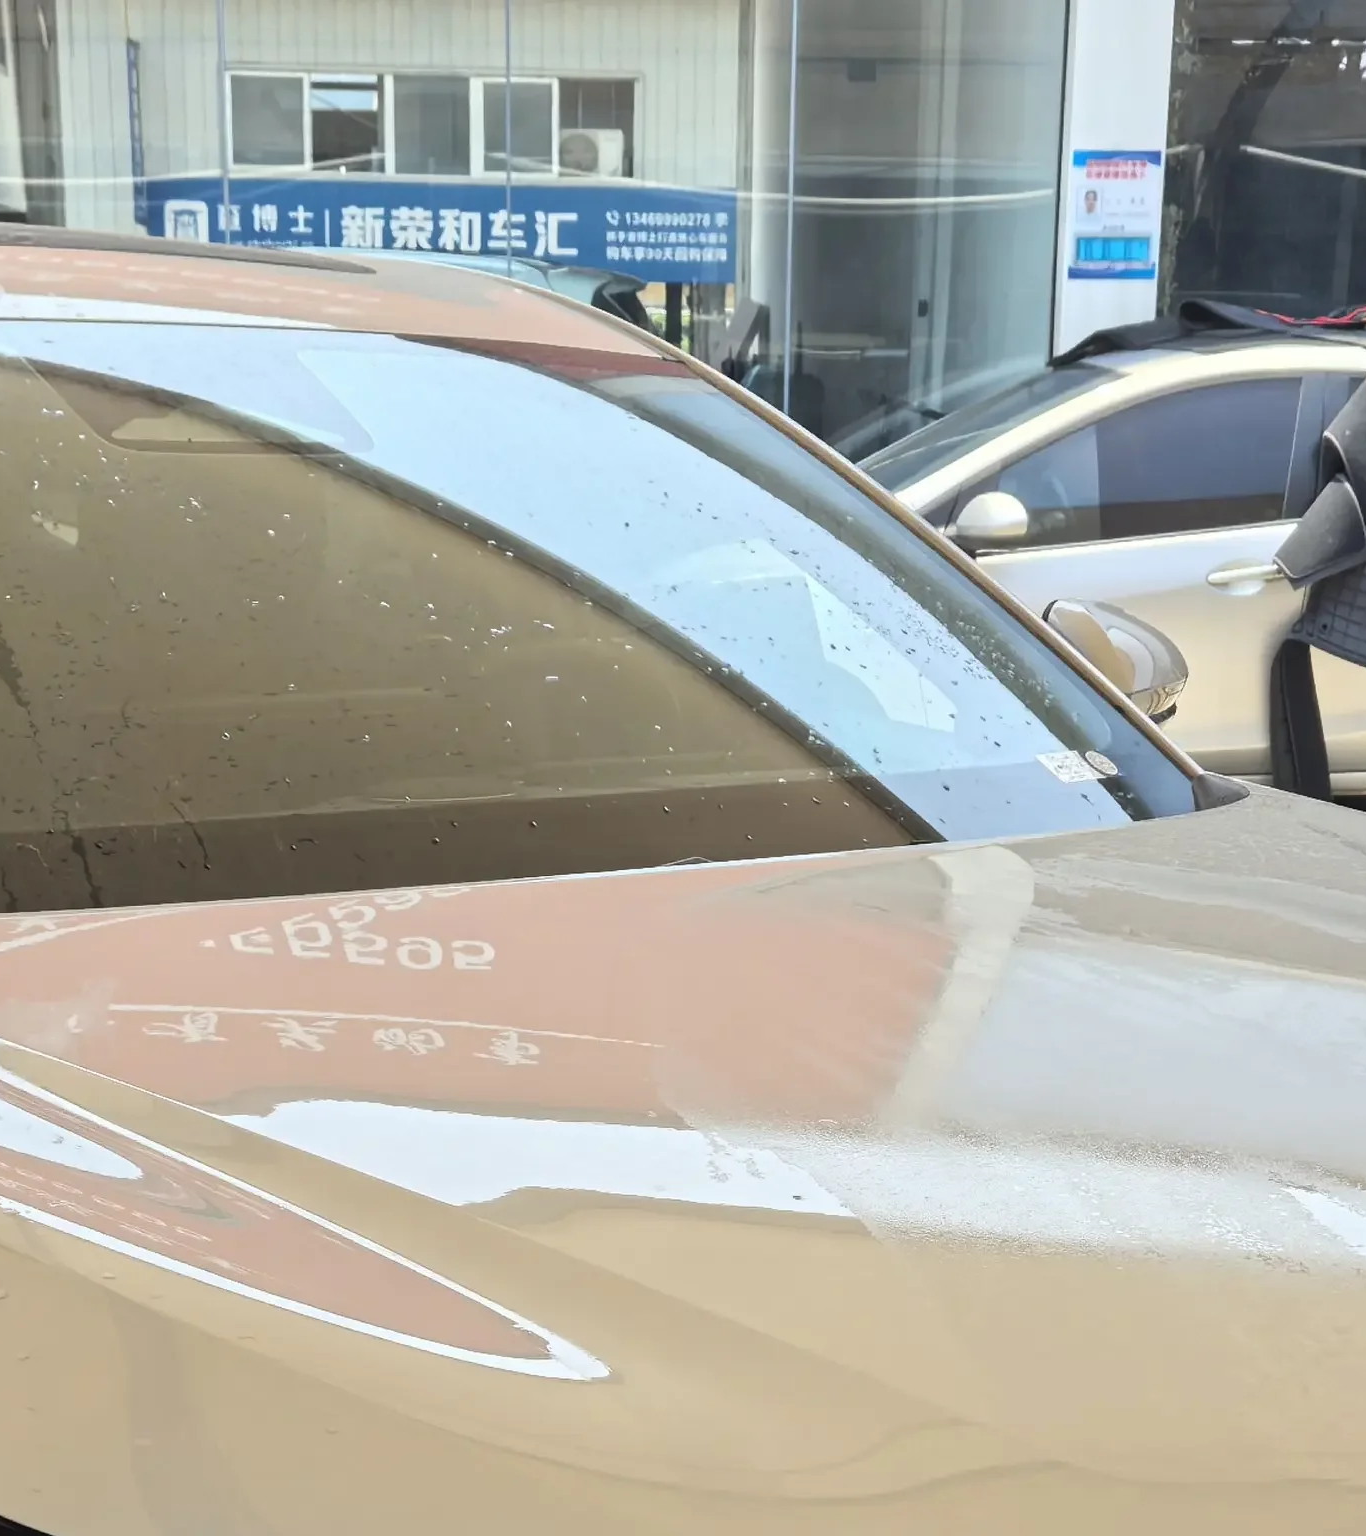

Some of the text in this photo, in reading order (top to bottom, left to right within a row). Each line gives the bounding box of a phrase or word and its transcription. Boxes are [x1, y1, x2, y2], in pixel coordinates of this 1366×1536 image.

[341, 205, 578, 257] 新荣和车汇
